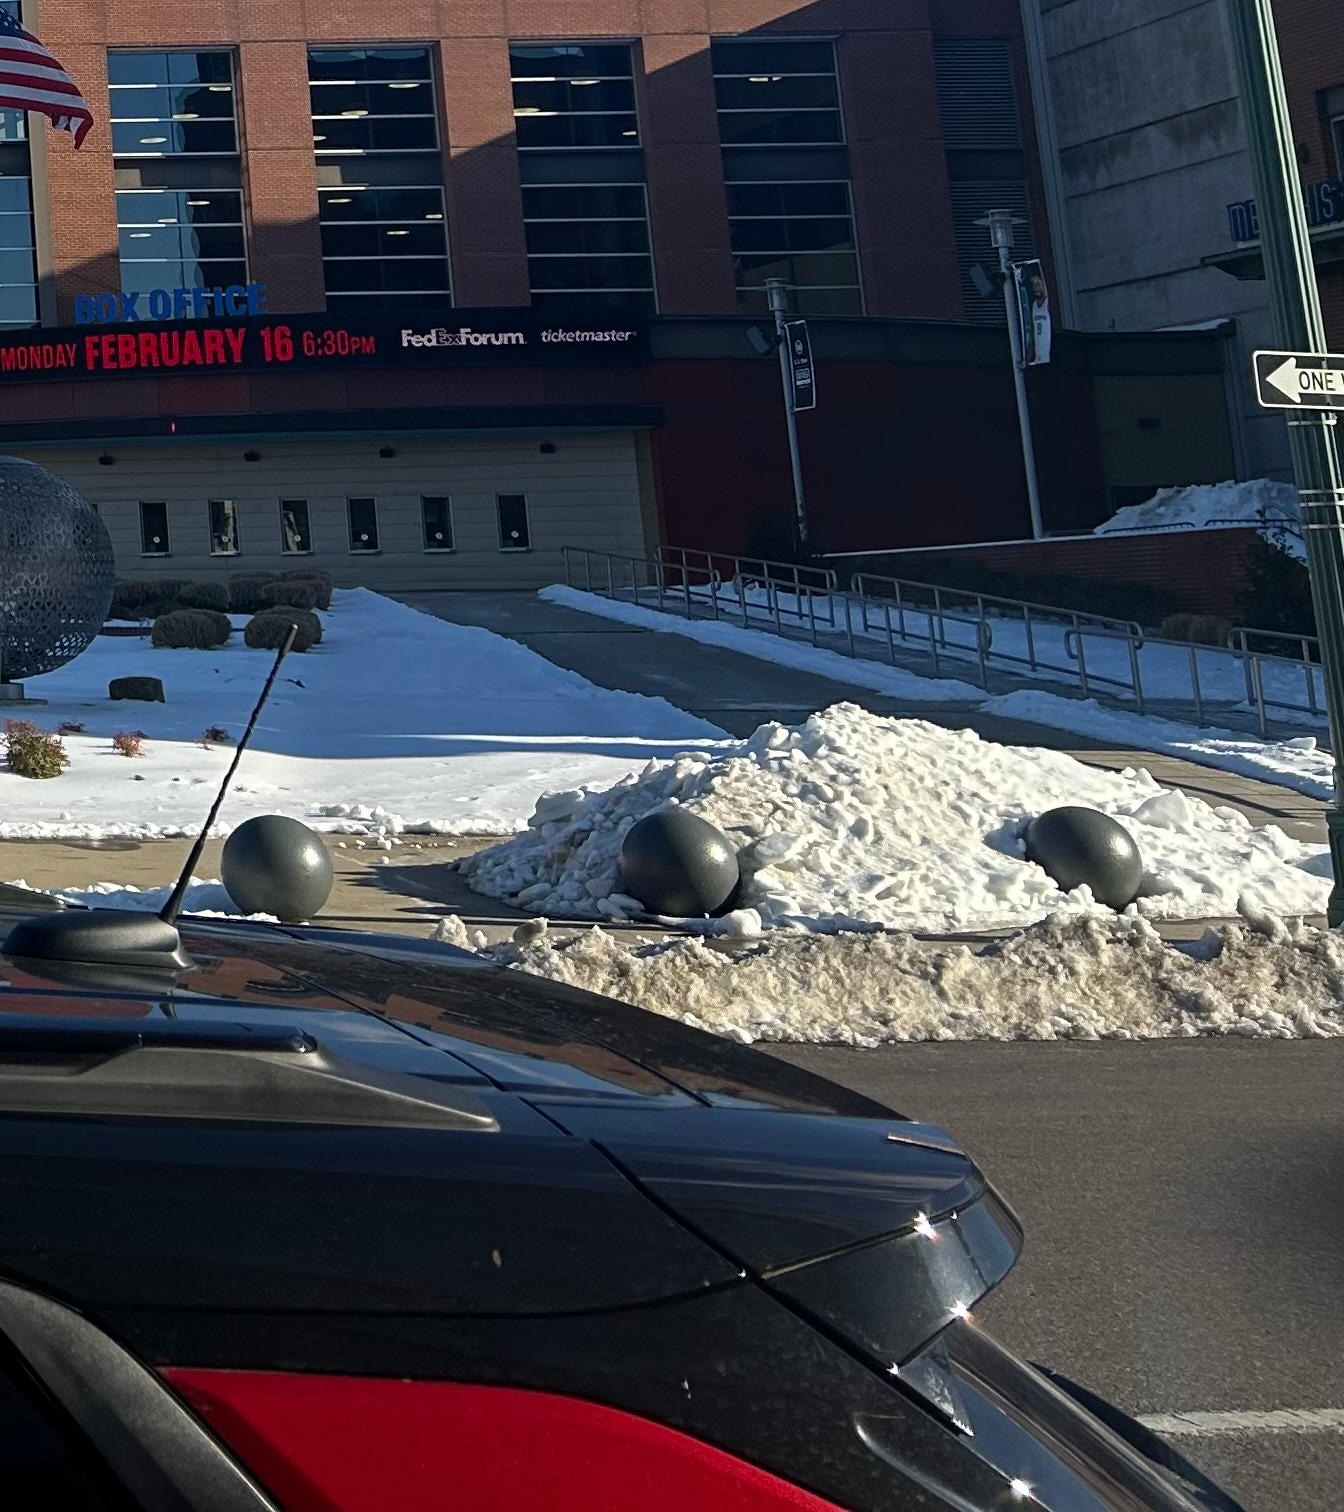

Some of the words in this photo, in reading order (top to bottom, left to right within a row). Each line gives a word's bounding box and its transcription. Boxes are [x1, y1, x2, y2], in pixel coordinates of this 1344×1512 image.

[74, 292, 140, 325] BOX
[149, 282, 267, 321] OFFICE
[0, 344, 77, 372] MONDAY
[84, 327, 246, 371] FEBRUARY
[261, 326, 295, 363] 16
[302, 330, 376, 357] 6:30PM
[541, 329, 632, 343] ticketmaster
[1298, 371, 1336, 391] ONE
